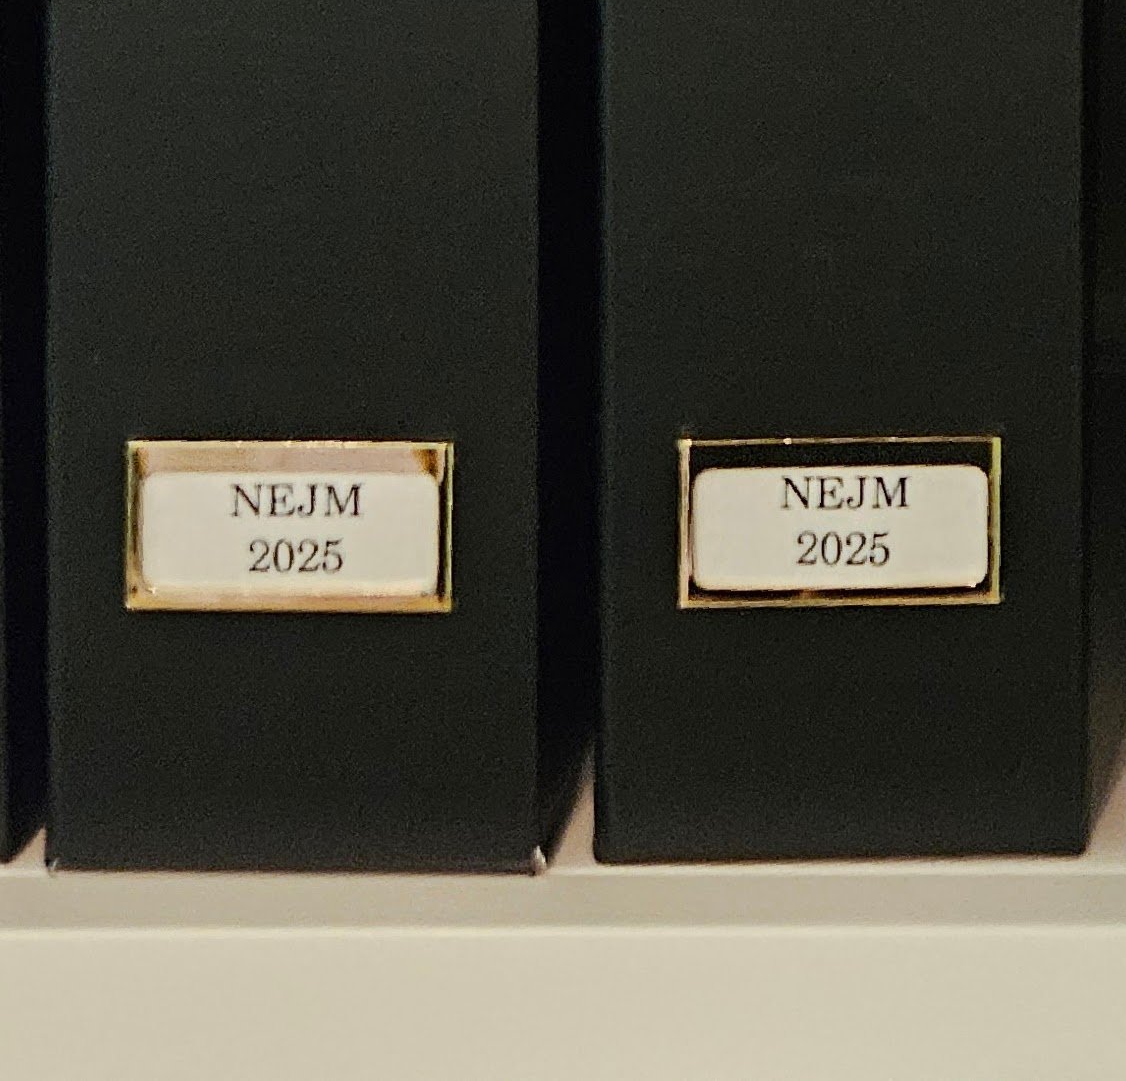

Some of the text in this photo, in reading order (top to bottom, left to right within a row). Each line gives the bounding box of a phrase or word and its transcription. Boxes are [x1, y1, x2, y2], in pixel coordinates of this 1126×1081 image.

[232, 484, 362, 518] NEJM
[781, 475, 910, 511] NEJM
[248, 539, 345, 574] 2025
[796, 531, 892, 567] 2025
